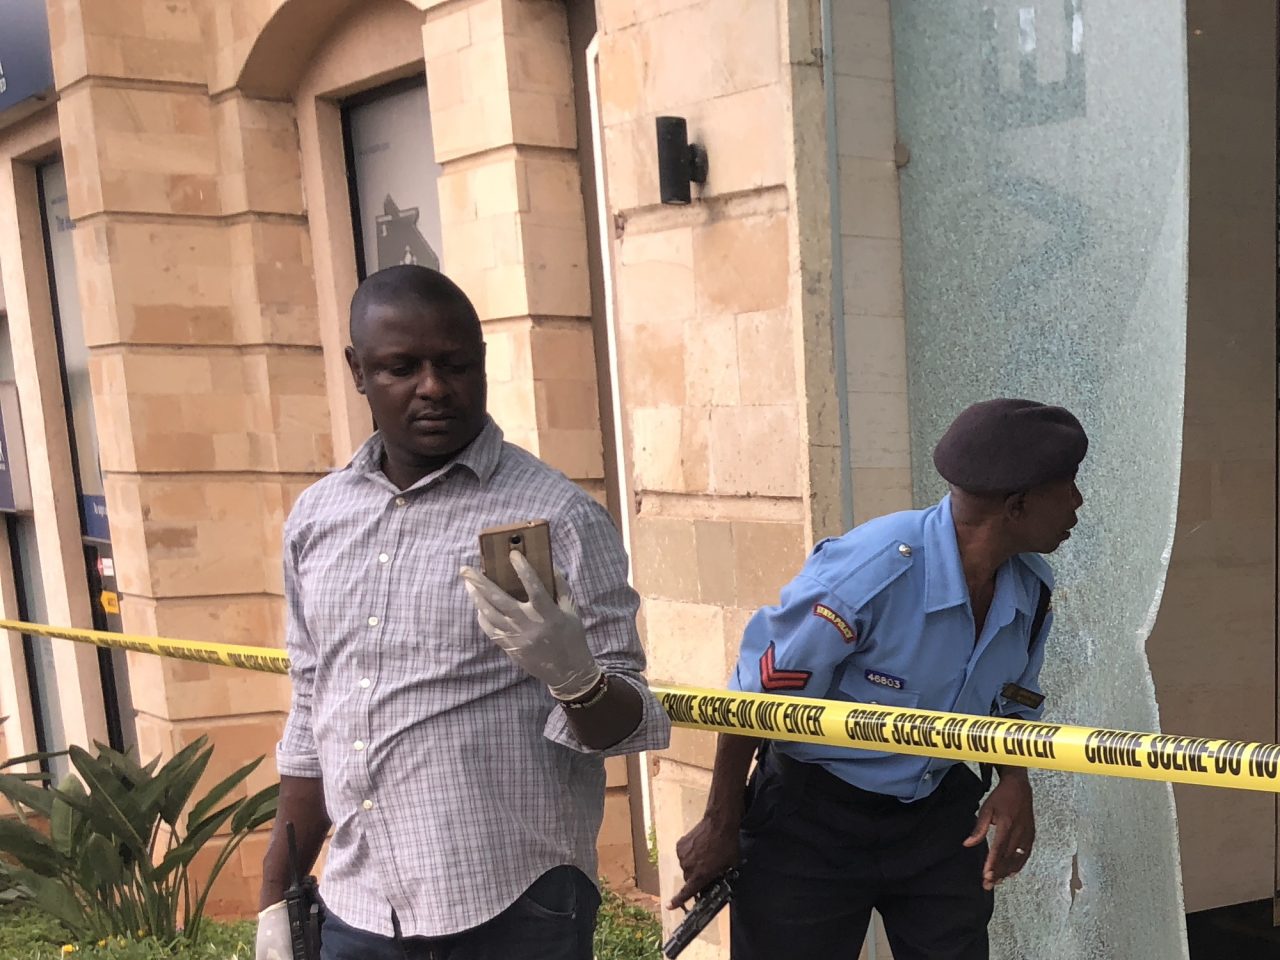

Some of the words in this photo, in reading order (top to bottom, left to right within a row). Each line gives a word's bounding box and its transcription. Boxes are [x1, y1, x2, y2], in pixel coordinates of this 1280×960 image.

[868, 673, 901, 689] 46803
[662, 692, 699, 724] CRIME
[755, 700, 785, 732] NOT
[783, 702, 826, 737] ENTER
[845, 708, 894, 744] CRIME
[966, 719, 1005, 754] NOT
[1003, 722, 1061, 760] ENTER
[1085, 729, 1150, 768] CRIME
